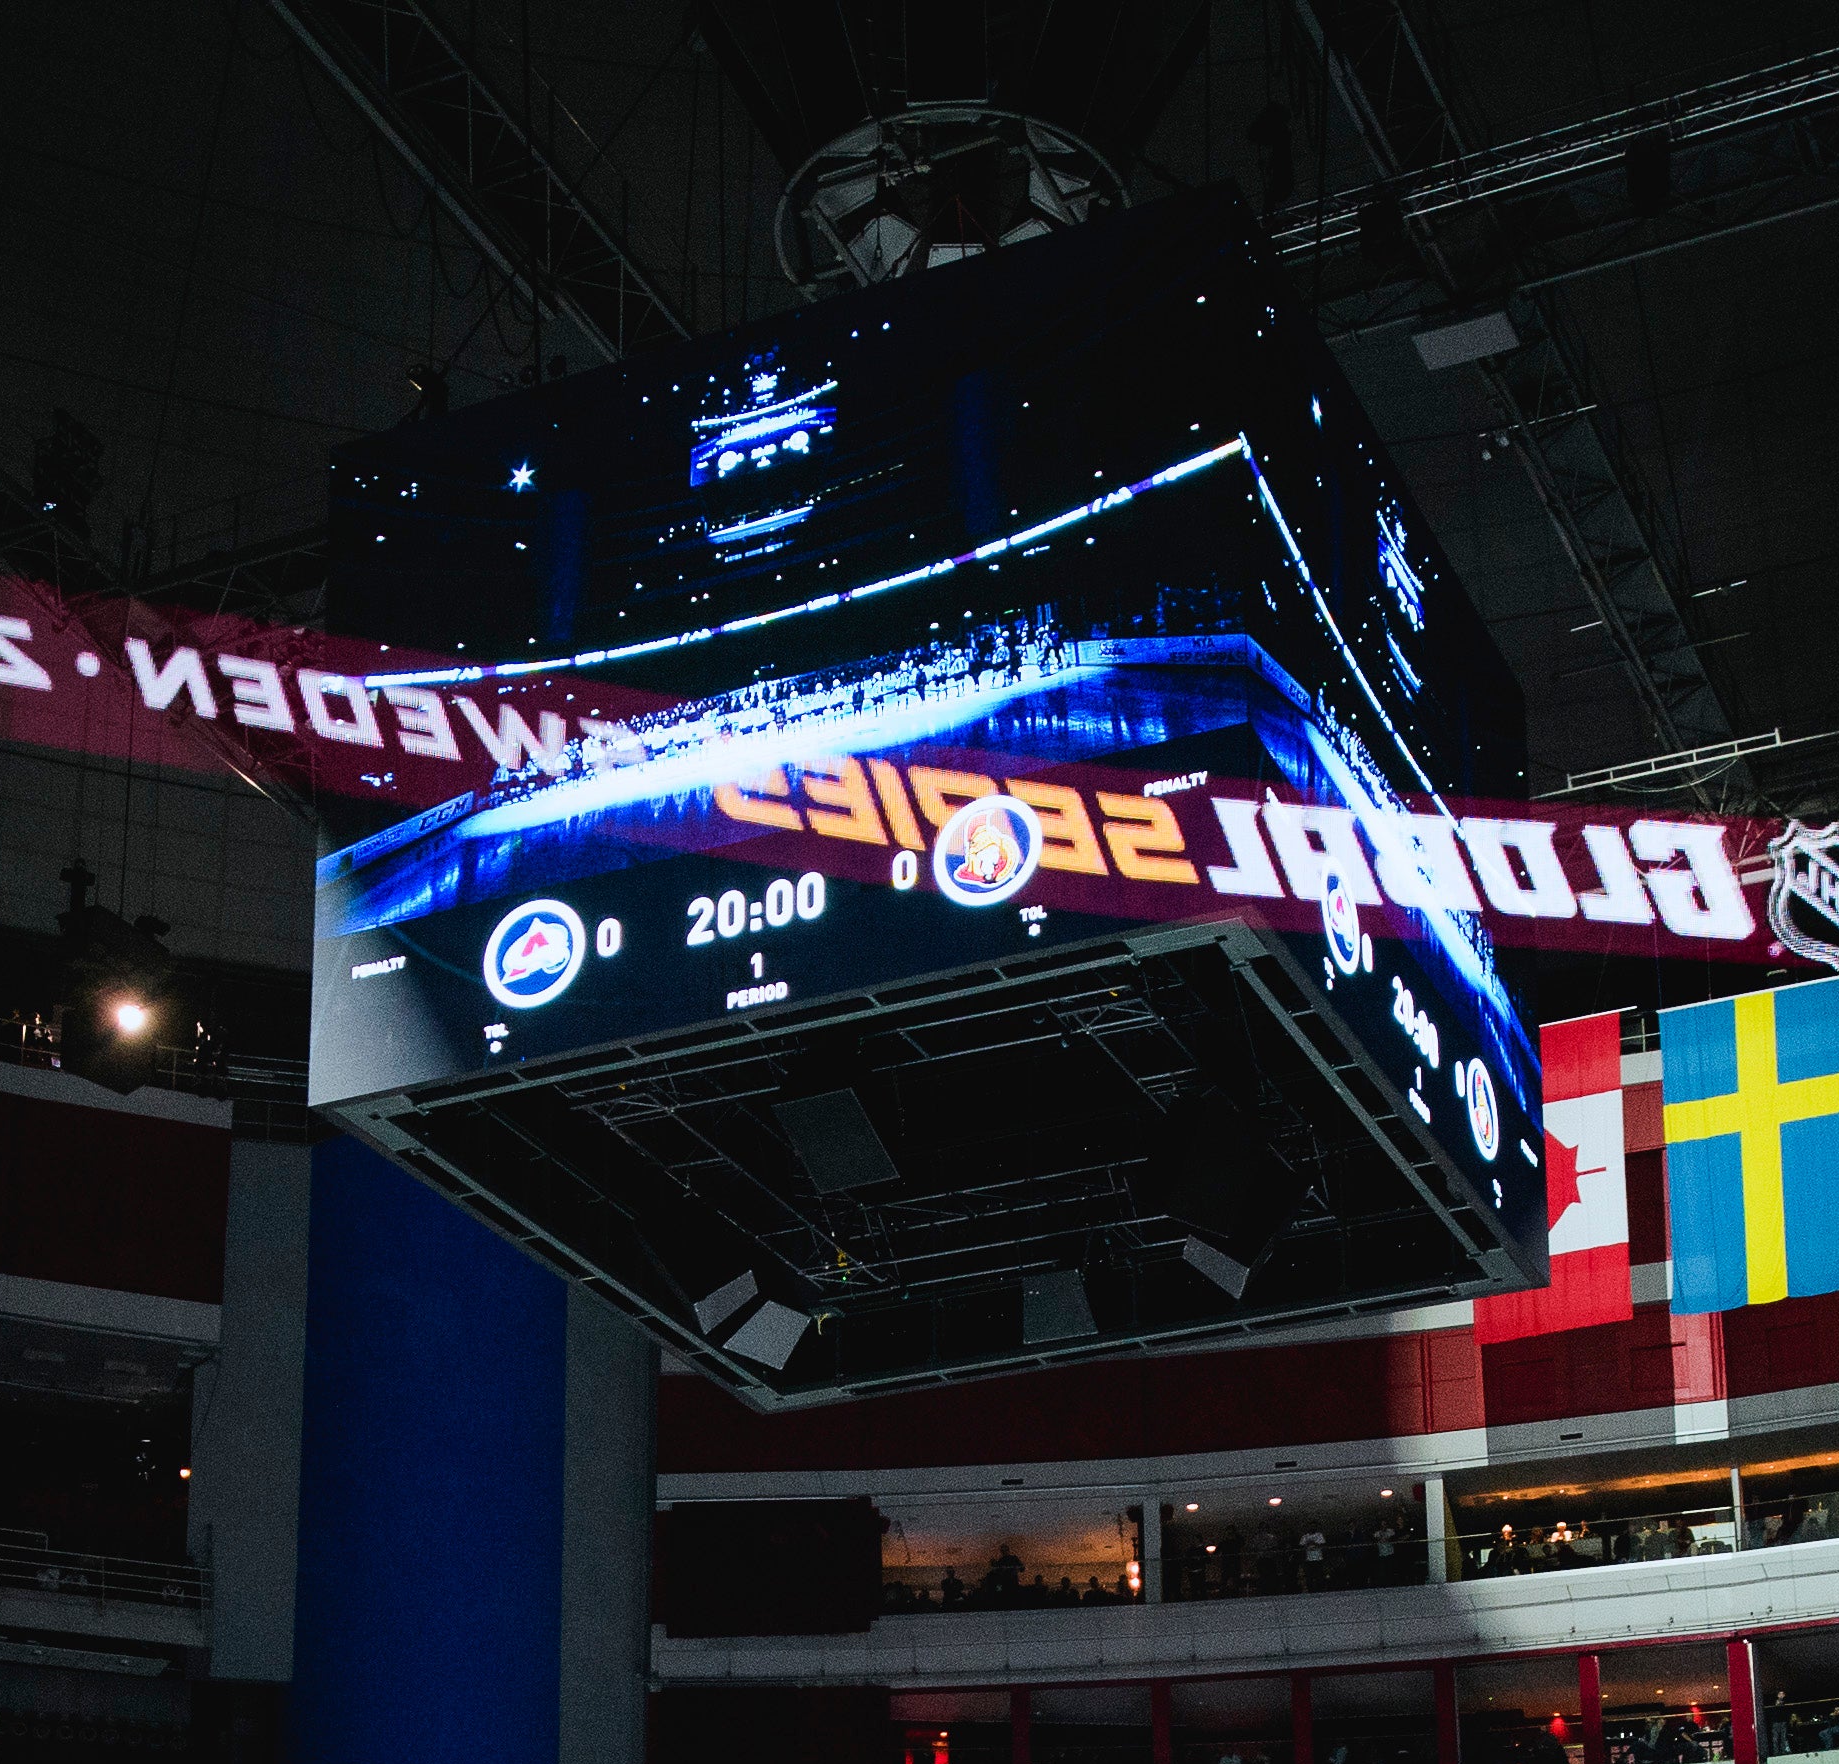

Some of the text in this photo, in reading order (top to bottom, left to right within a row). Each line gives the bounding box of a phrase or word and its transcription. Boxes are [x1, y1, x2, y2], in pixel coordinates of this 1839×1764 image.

[1143, 771, 1209, 798] PENALTY
[892, 850, 918, 890] 0
[686, 870, 827, 947] 20:00
[596, 917, 622, 957] 0
[750, 952, 764, 979] 1
[726, 981, 789, 1010] PERIOD
